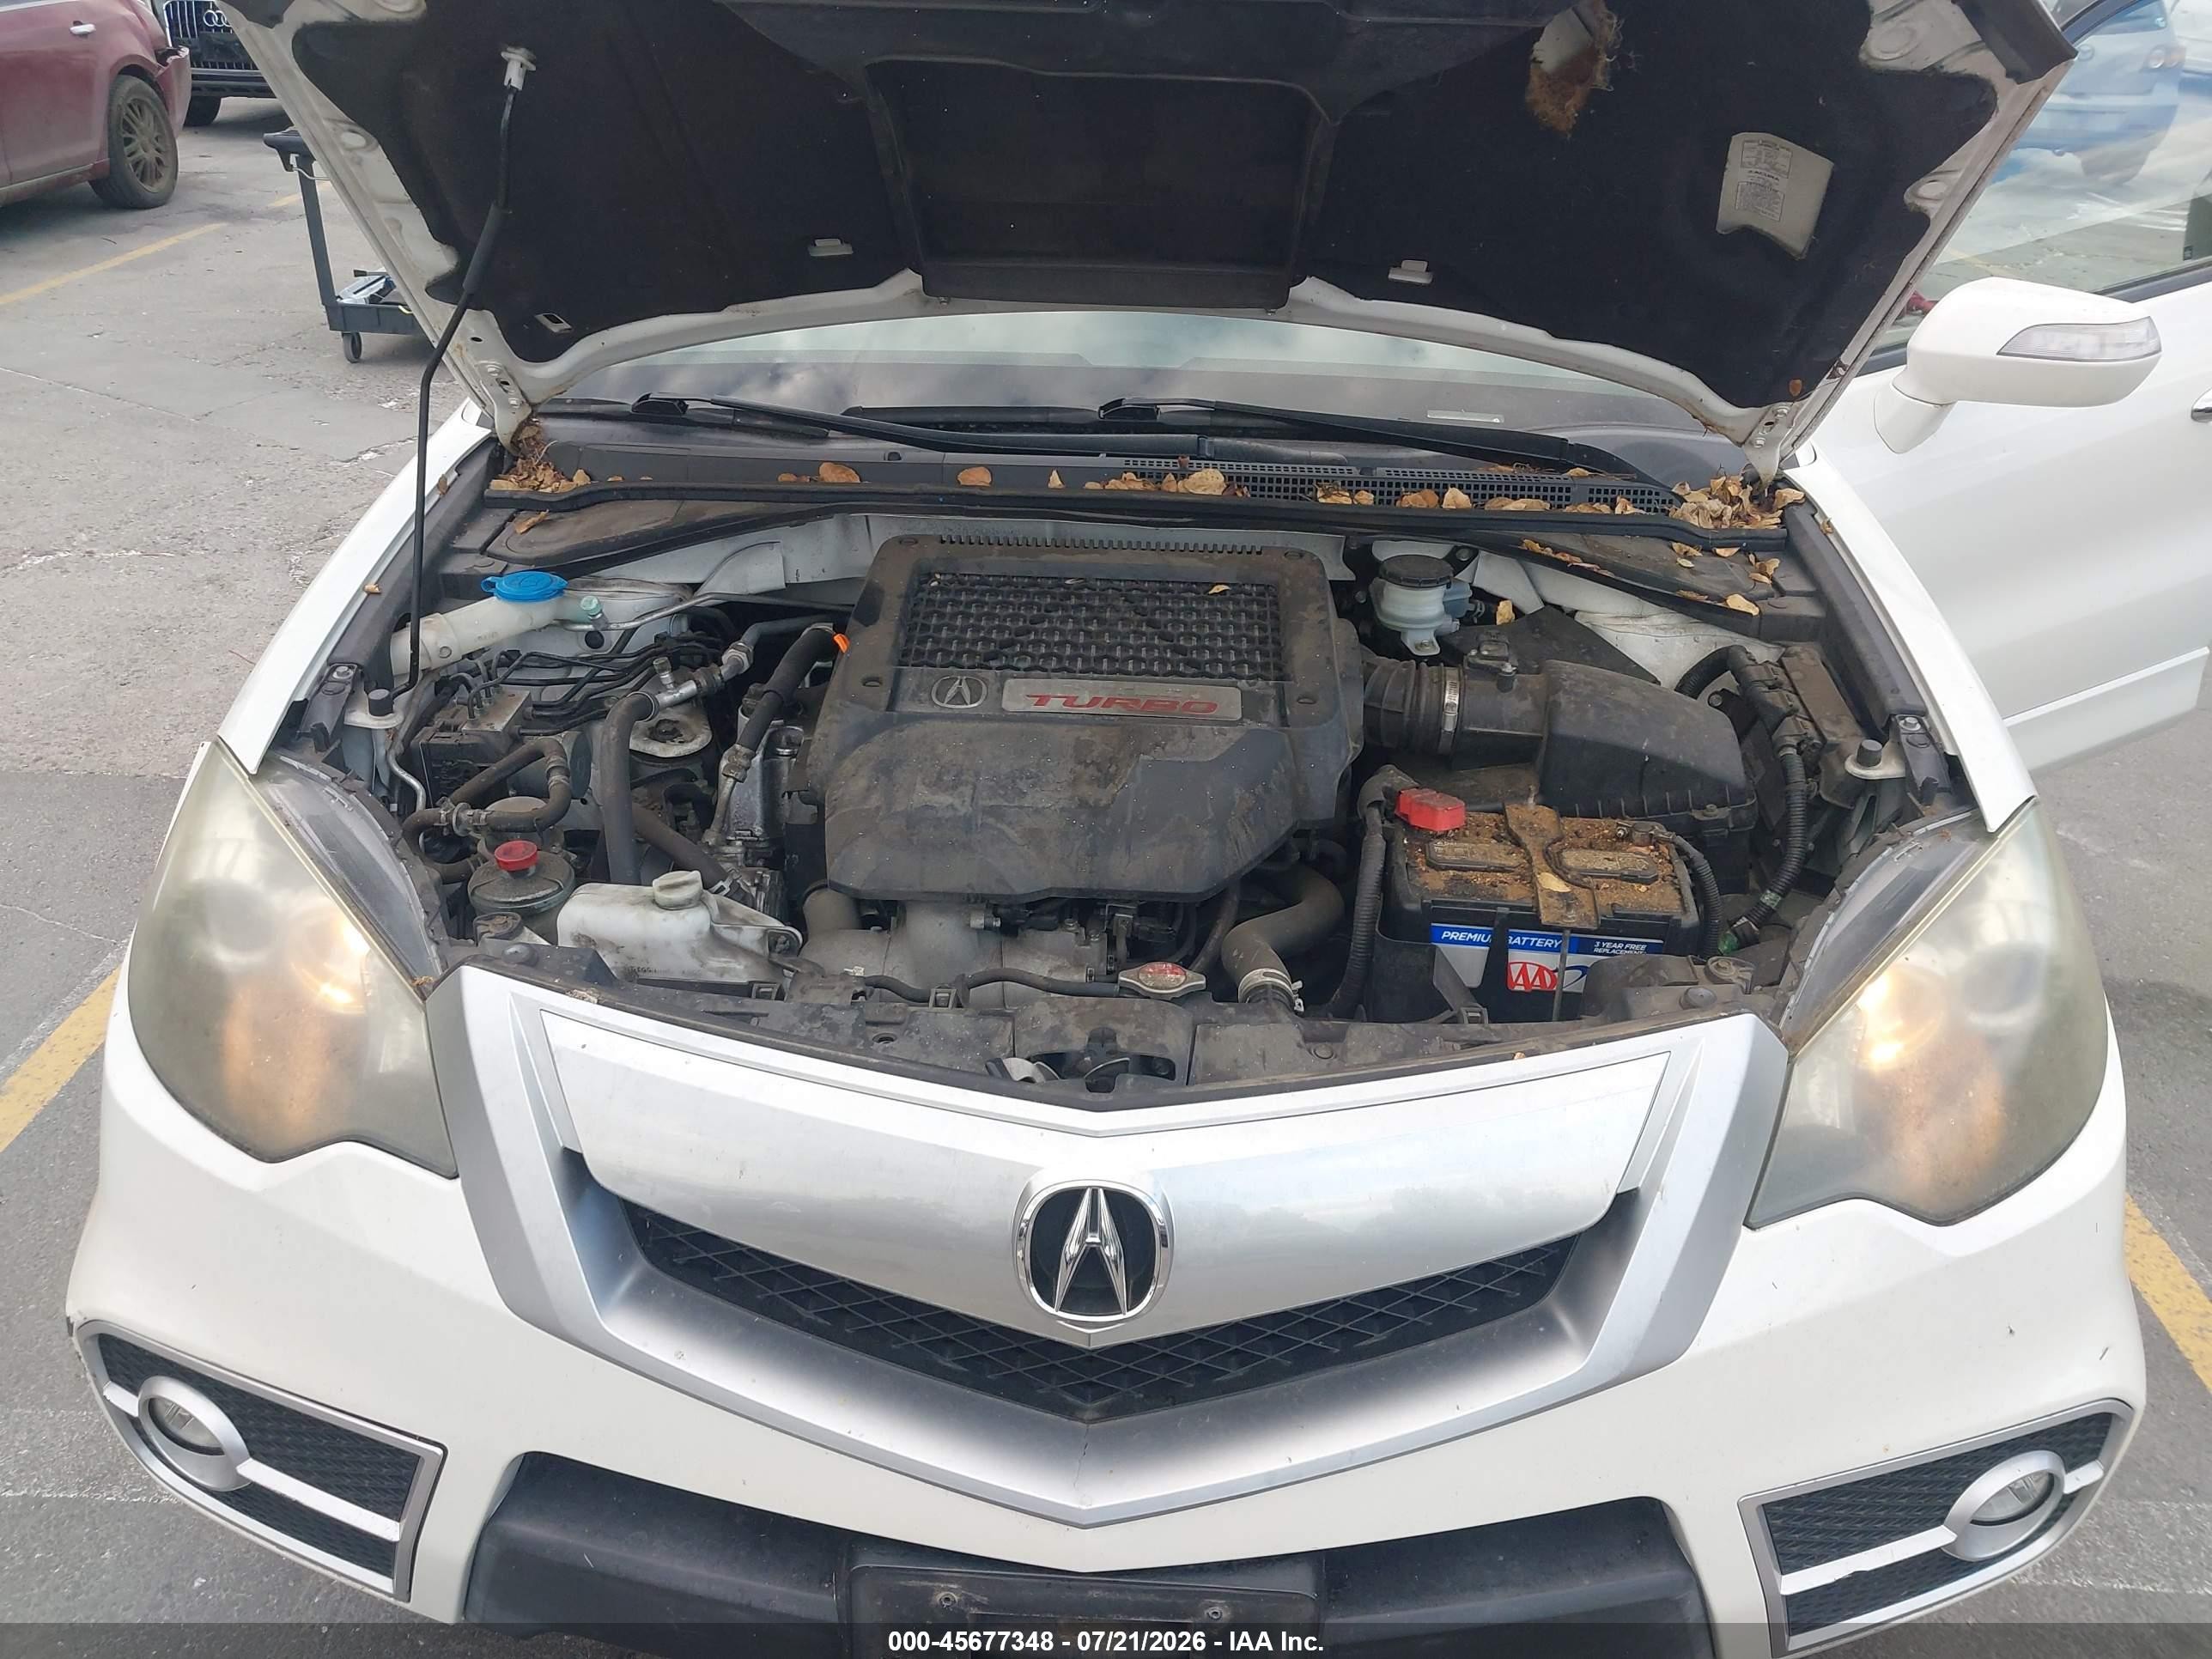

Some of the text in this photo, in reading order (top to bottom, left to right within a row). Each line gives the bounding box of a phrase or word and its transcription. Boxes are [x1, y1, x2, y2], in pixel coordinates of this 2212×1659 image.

[1025, 694, 1219, 715] TURBO
[1442, 930, 1492, 943] PREMIU
[1601, 941, 1624, 950] YEAR
